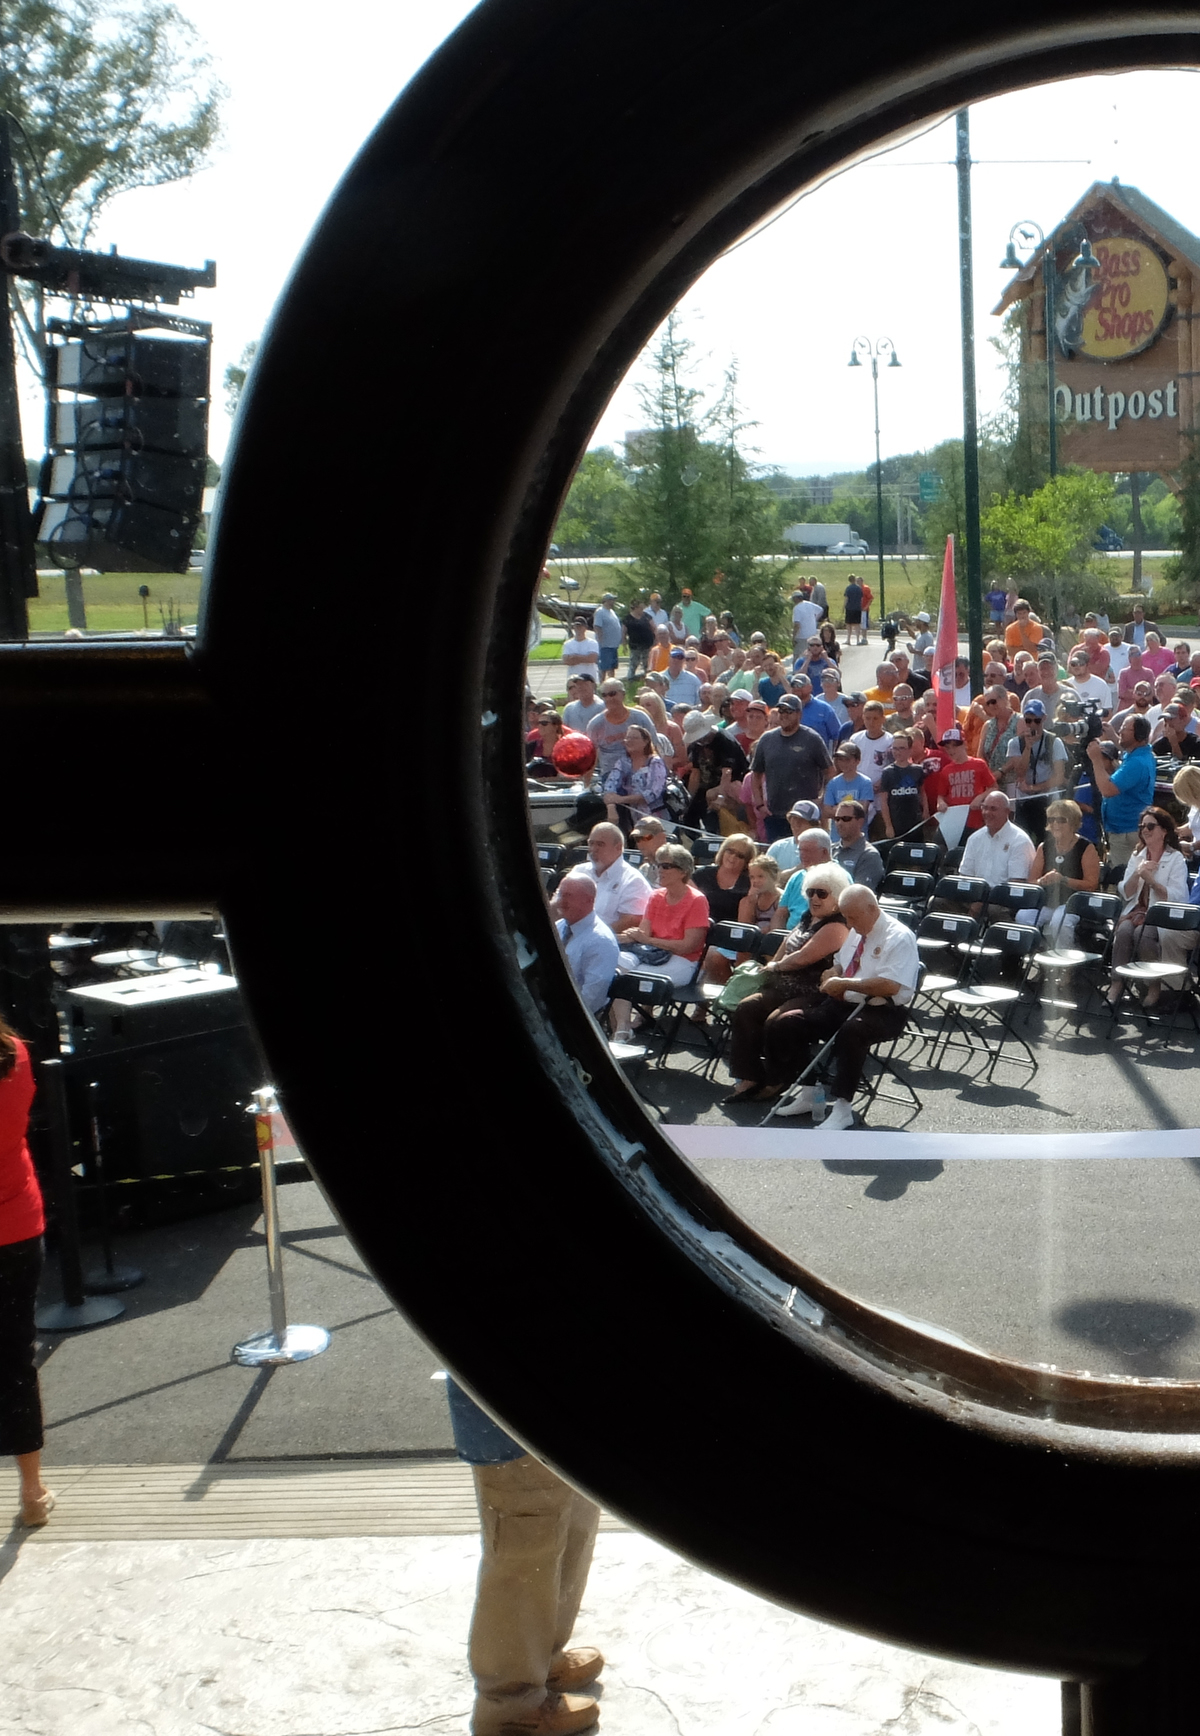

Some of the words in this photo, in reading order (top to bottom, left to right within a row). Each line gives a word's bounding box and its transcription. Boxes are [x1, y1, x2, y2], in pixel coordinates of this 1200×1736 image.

[1093, 247, 1140, 279] Bass
[1097, 280, 1131, 310] Pro
[1095, 309, 1154, 343] Shops
[1056, 381, 1177, 430] Outpost
[949, 770, 975, 785] GAME
[951, 784, 974, 797] OVER
